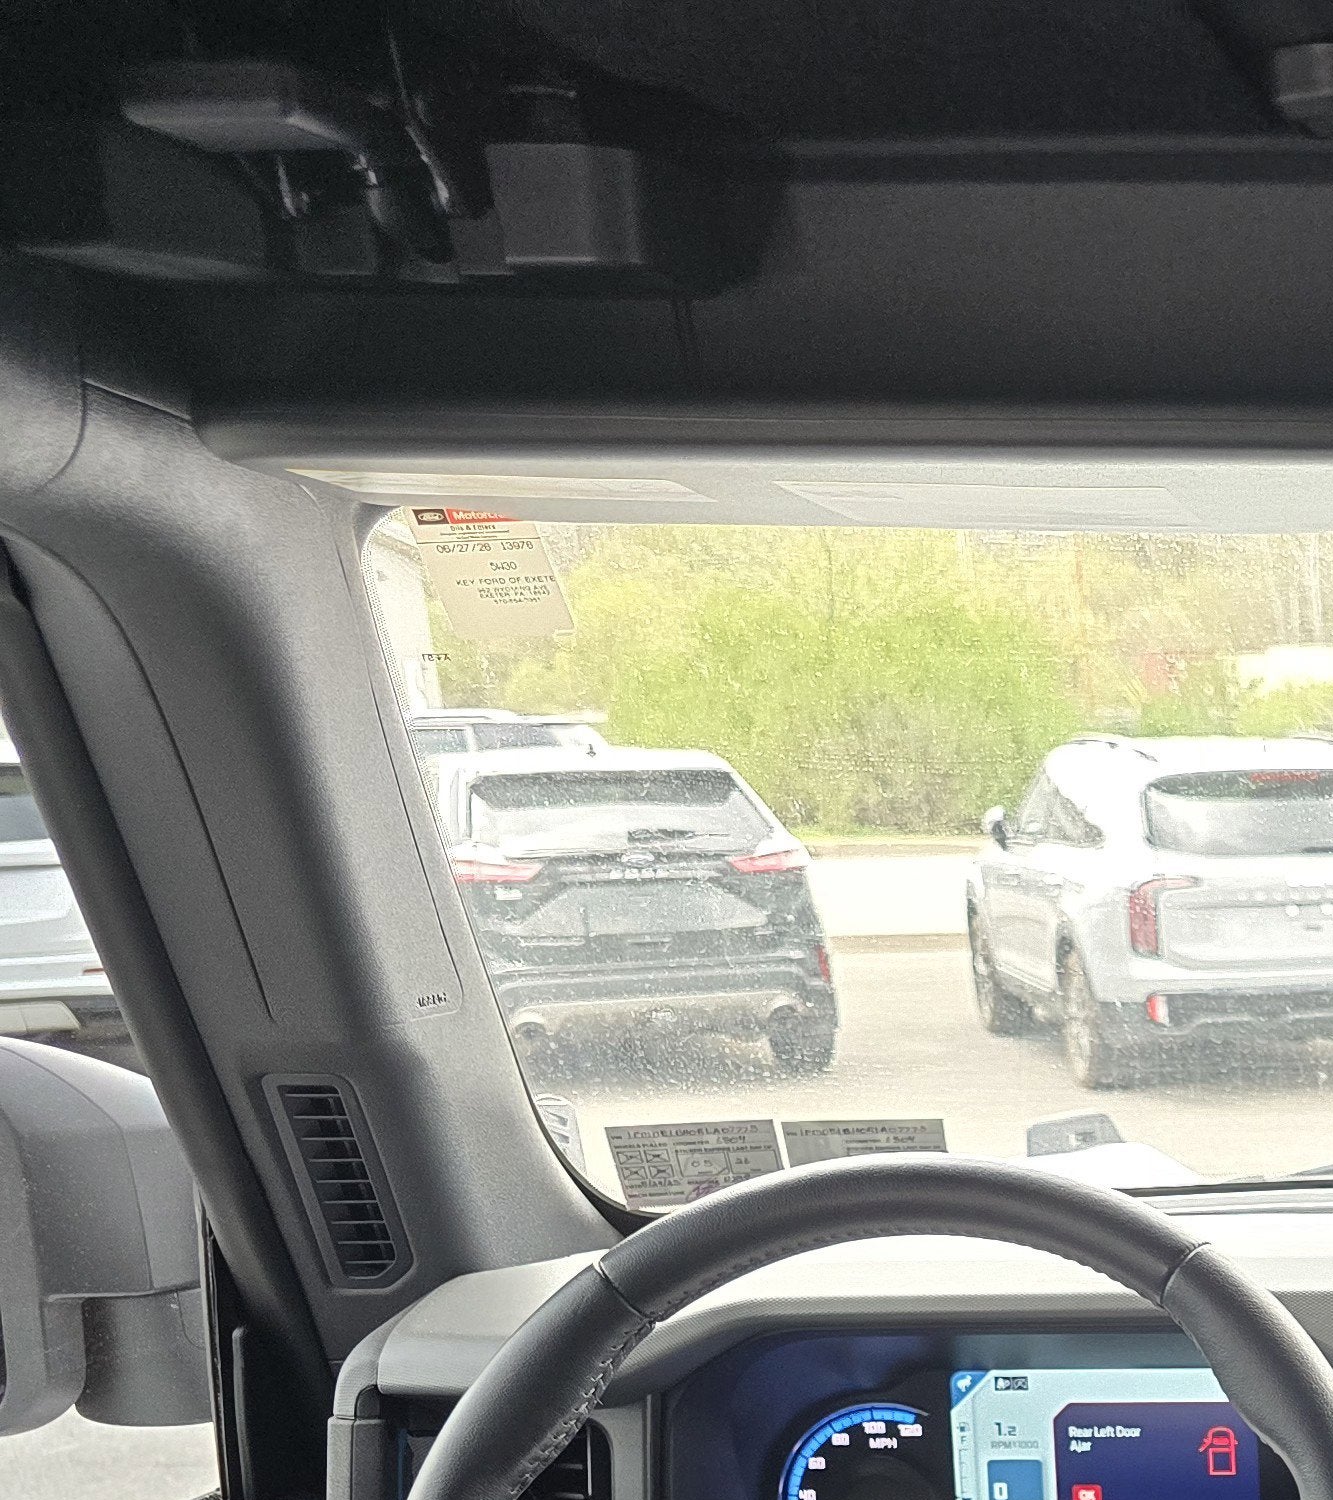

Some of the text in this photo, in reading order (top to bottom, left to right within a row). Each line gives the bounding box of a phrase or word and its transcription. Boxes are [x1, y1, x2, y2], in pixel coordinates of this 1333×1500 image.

[479, 577, 506, 585] FORD
[994, 1422, 1017, 1437] 1.2
[1069, 1426, 1141, 1439] Rear Left Door
